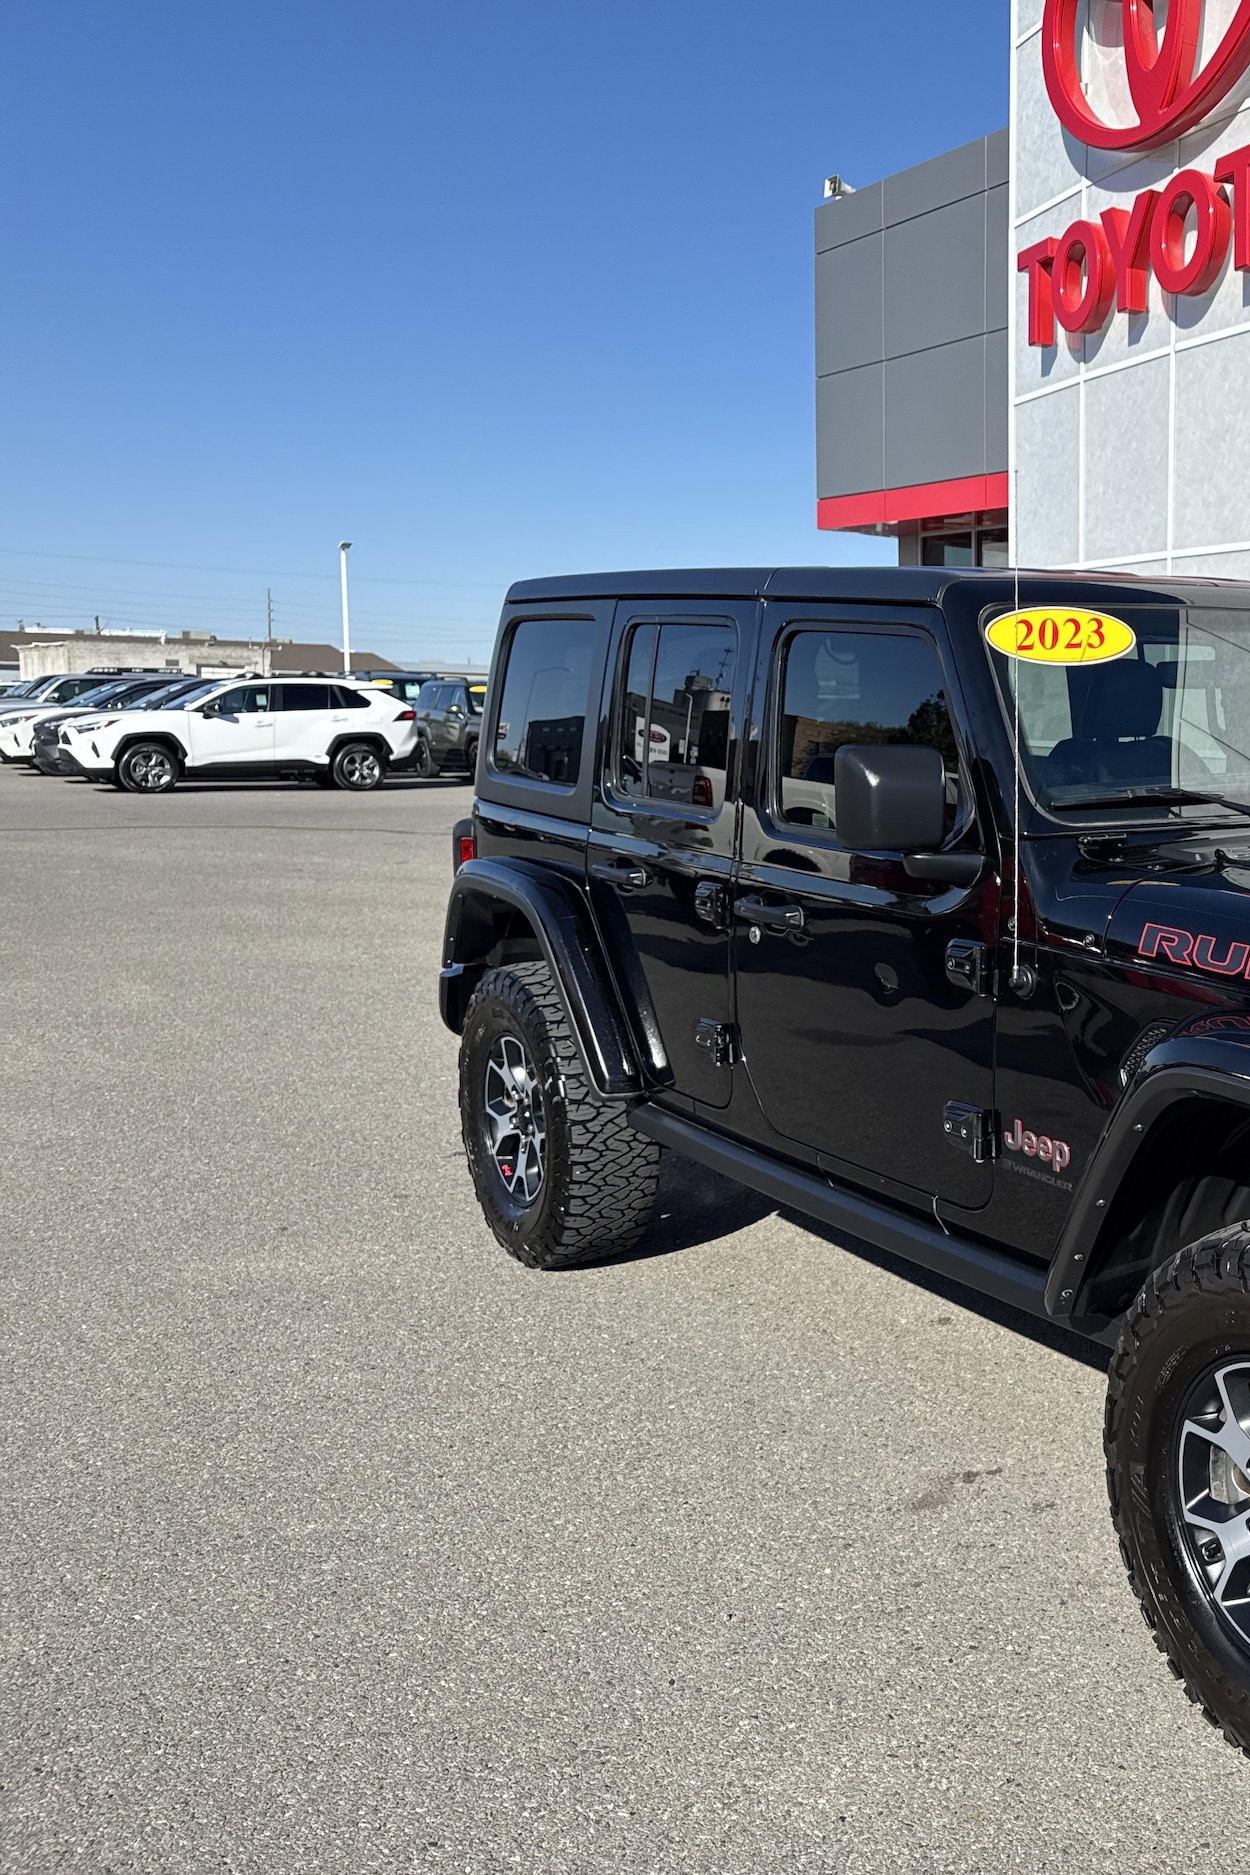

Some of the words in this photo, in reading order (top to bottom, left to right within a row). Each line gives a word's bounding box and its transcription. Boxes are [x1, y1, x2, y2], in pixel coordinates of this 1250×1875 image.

[1015, 617, 1106, 651] 2023
[1003, 1118, 1071, 1173] Jeep
[1011, 1161, 1074, 1193] WRANGLER
